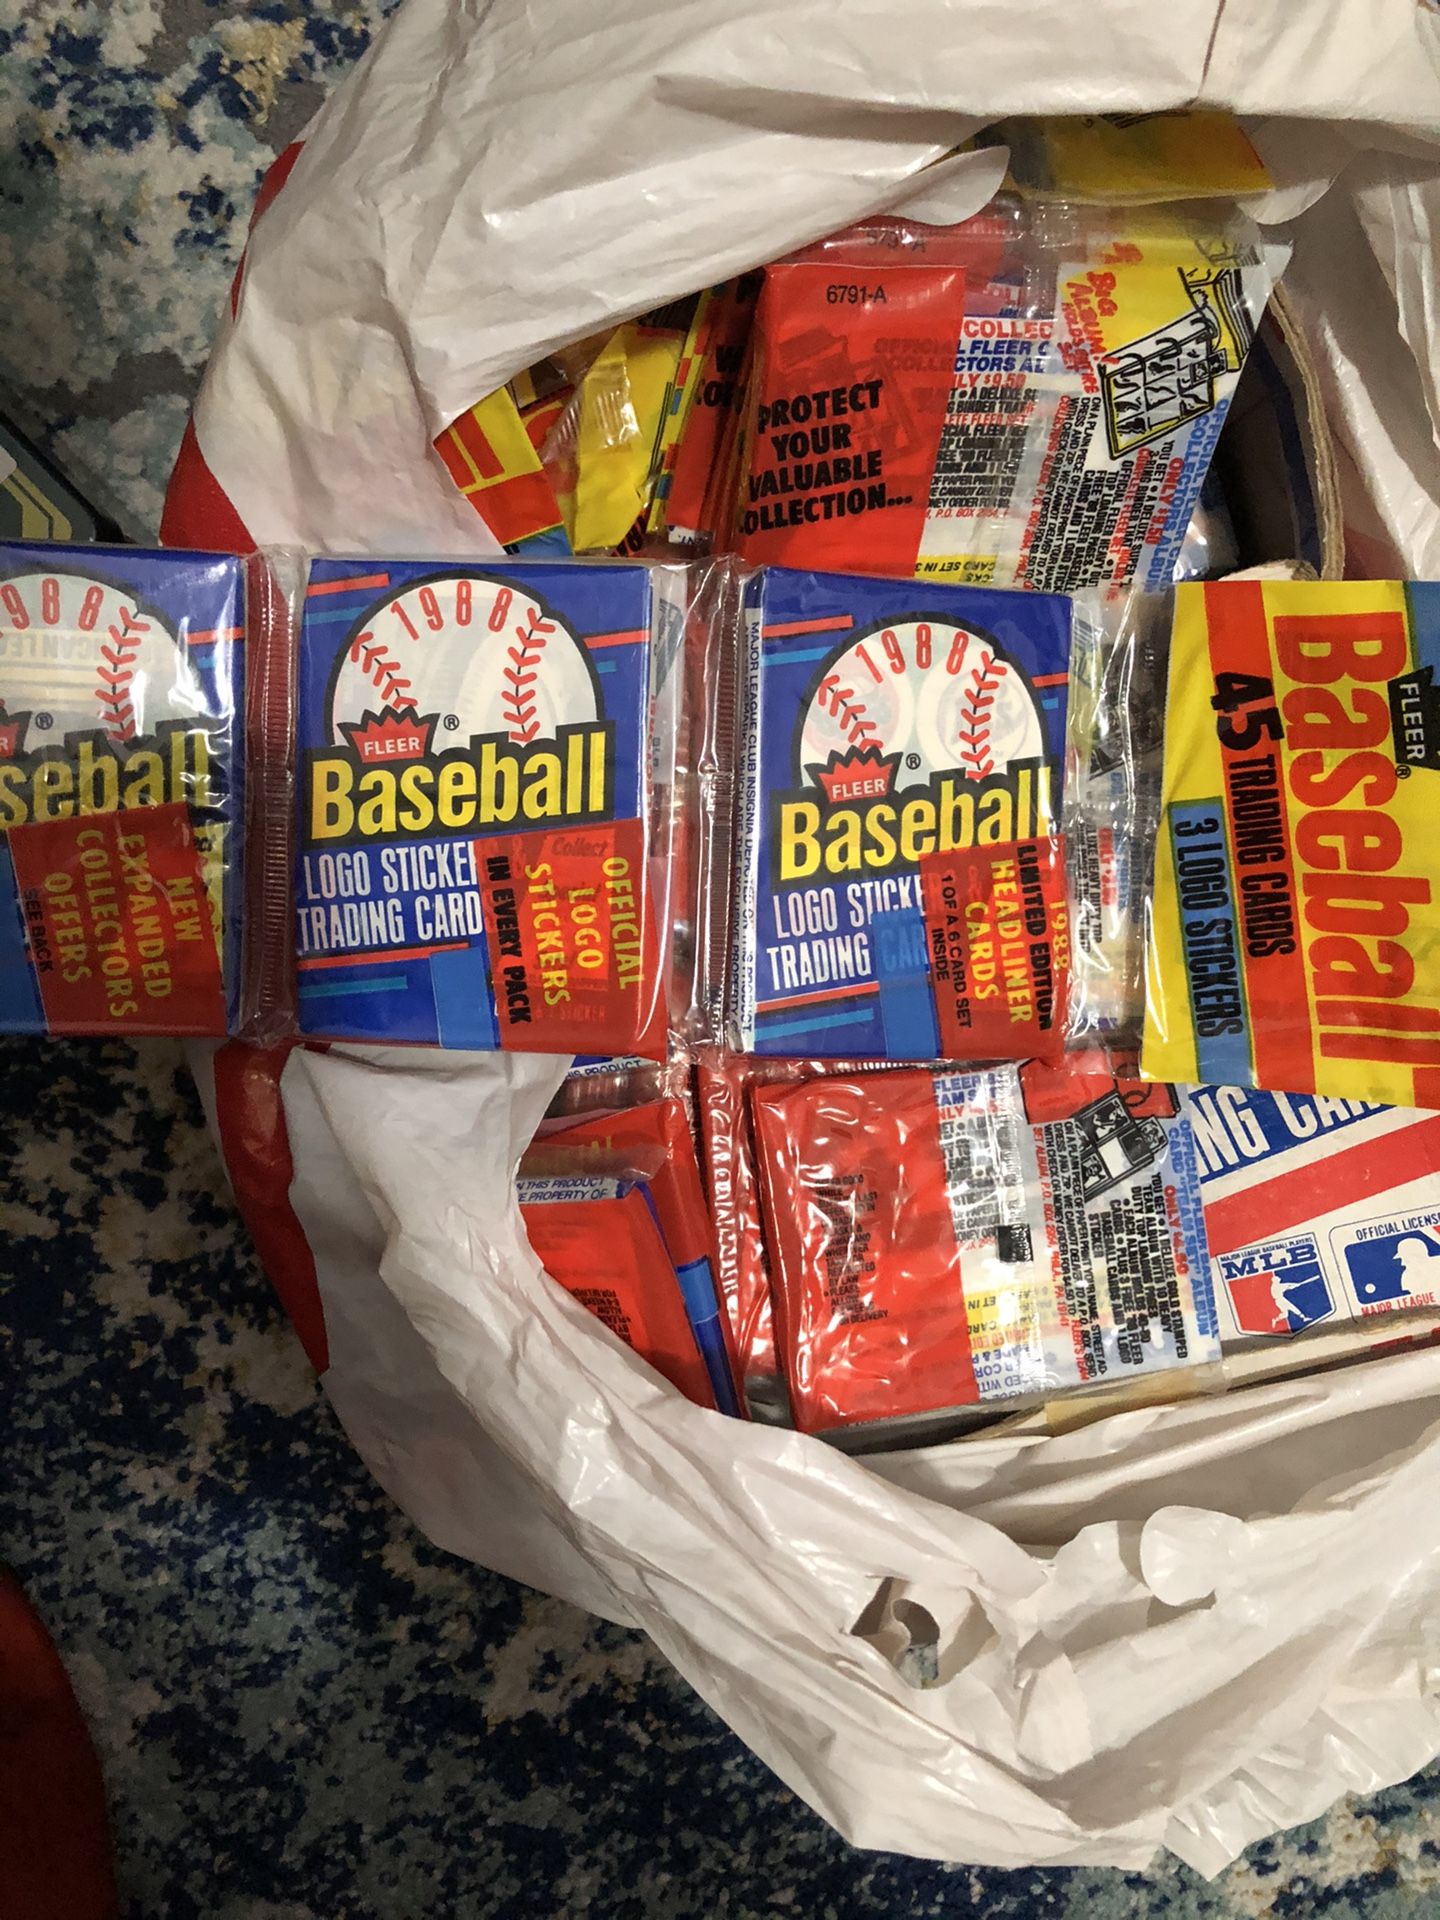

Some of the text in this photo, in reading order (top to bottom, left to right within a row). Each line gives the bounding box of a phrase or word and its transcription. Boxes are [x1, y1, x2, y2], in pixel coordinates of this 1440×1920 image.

[826, 284, 888, 305] 6791-A
[1066, 281, 1122, 365] ALBUM!
[1087, 270, 1119, 318] BIG
[969, 340, 1031, 355] FLEER
[758, 380, 883, 435] PROTECT
[771, 424, 852, 462] YOUR
[750, 450, 883, 503] VALUABLE
[1037, 421, 1073, 526] CHECK ORDER
[1041, 396, 1092, 555] DRESS AND WE CANNOT DELIVER
[1049, 396, 1102, 566] ON PLAIN PIECE PAPER PRINT YOUR
[1077, 468, 1109, 544] FREE FLEER
[1093, 459, 1135, 569] OFFICIAL FLEER HEAVY
[1105, 468, 1121, 491] TOP
[1124, 438, 1175, 576] YOU GET DELUXE SUPER
[1130, 484, 1149, 521] BINDER
[1146, 456, 1185, 547] ONLY $9.50
[1166, 413, 1211, 531] COLLECTORS
[1061, 468, 1097, 563] CARDS LOGO
[390, 580, 513, 641] 1988
[856, 623, 969, 684] 1988
[363, 736, 421, 757] FLEER
[745, 621, 760, 834] MAJOR LEAGUE CLUB INSIGNIA
[1399, 683, 1425, 760] FLEER
[311, 731, 607, 840] Baseball
[780, 766, 1052, 880] Baseball
[832, 779, 887, 800] FLEER
[1210, 671, 1297, 958] 45 TRADING CARDS
[303, 850, 372, 901] LOGO
[1088, 857, 1099, 889] HEAVY
[1273, 611, 1440, 1068] Baseball
[22, 886, 55, 973] SEE BACK
[44, 872, 92, 984] OFFERS
[77, 829, 138, 1018] COLLECTORS
[117, 834, 173, 998] EXPANDED
[166, 876, 203, 942] NEW
[297, 898, 406, 952] TRADING
[487, 855, 532, 1025] IN EVERY PACK
[524, 863, 571, 1006] STICKERS
[568, 888, 604, 969] LOGO
[602, 856, 645, 990] OFFICIAL
[772, 886, 834, 940] LOGO
[940, 874, 971, 1029] 1 OF A CARD SET
[964, 901, 1000, 1001] CARDS
[990, 860, 1033, 1024] HEADLINER
[1016, 845, 1053, 1032] LIMITED EDITION
[1048, 900, 1072, 971] 1988
[1092, 923, 1102, 943] TOP
[1175, 817, 1243, 1039] 3 LOGO STICKERS
[732, 945, 740, 1015] PROPERTY
[766, 933, 873, 992] TRADING
[931, 926, 949, 981] INSIDE
[526, 1180, 549, 1190] THIS
[529, 1188, 609, 1202] PROPERTY OF
[1042, 1123, 1071, 1255] WITH CHECK OR MONEY ORDER
[1163, 1183, 1182, 1230] ONLY
[1179, 1119, 1208, 1251] OFFICIAL FLEER
[1053, 1122, 1096, 1377] DRESS AND WE CANNOT SEND
[1064, 1121, 1104, 1359] ON PLAIN PIECE PAPER STREET
[1088, 1212, 1104, 1259] STICKER
[1100, 1211, 1126, 1325] BASEBALL CARDS AND
[1123, 1208, 1141, 1274] EACH ALBUM
[1131, 1186, 1154, 1284] DUTY TOP LOADING
[1141, 1184, 1172, 1333] TEAM ALBUM WITH HEAVY
[1150, 1171, 1187, 1359] YOU GET DELUXE GOLD STAMPED
[1167, 1126, 1210, 1336] CARD ALBUM
[1221, 1244, 1317, 1279] MLB
[1355, 1223, 1401, 1241] OFFICIAL
[851, 1309, 889, 1322] DELIVERY
[1110, 1198, 1143, 1365] CARDS PLUS FLEER
[1361, 1292, 1437, 1318] MAJOR LEAGUE
